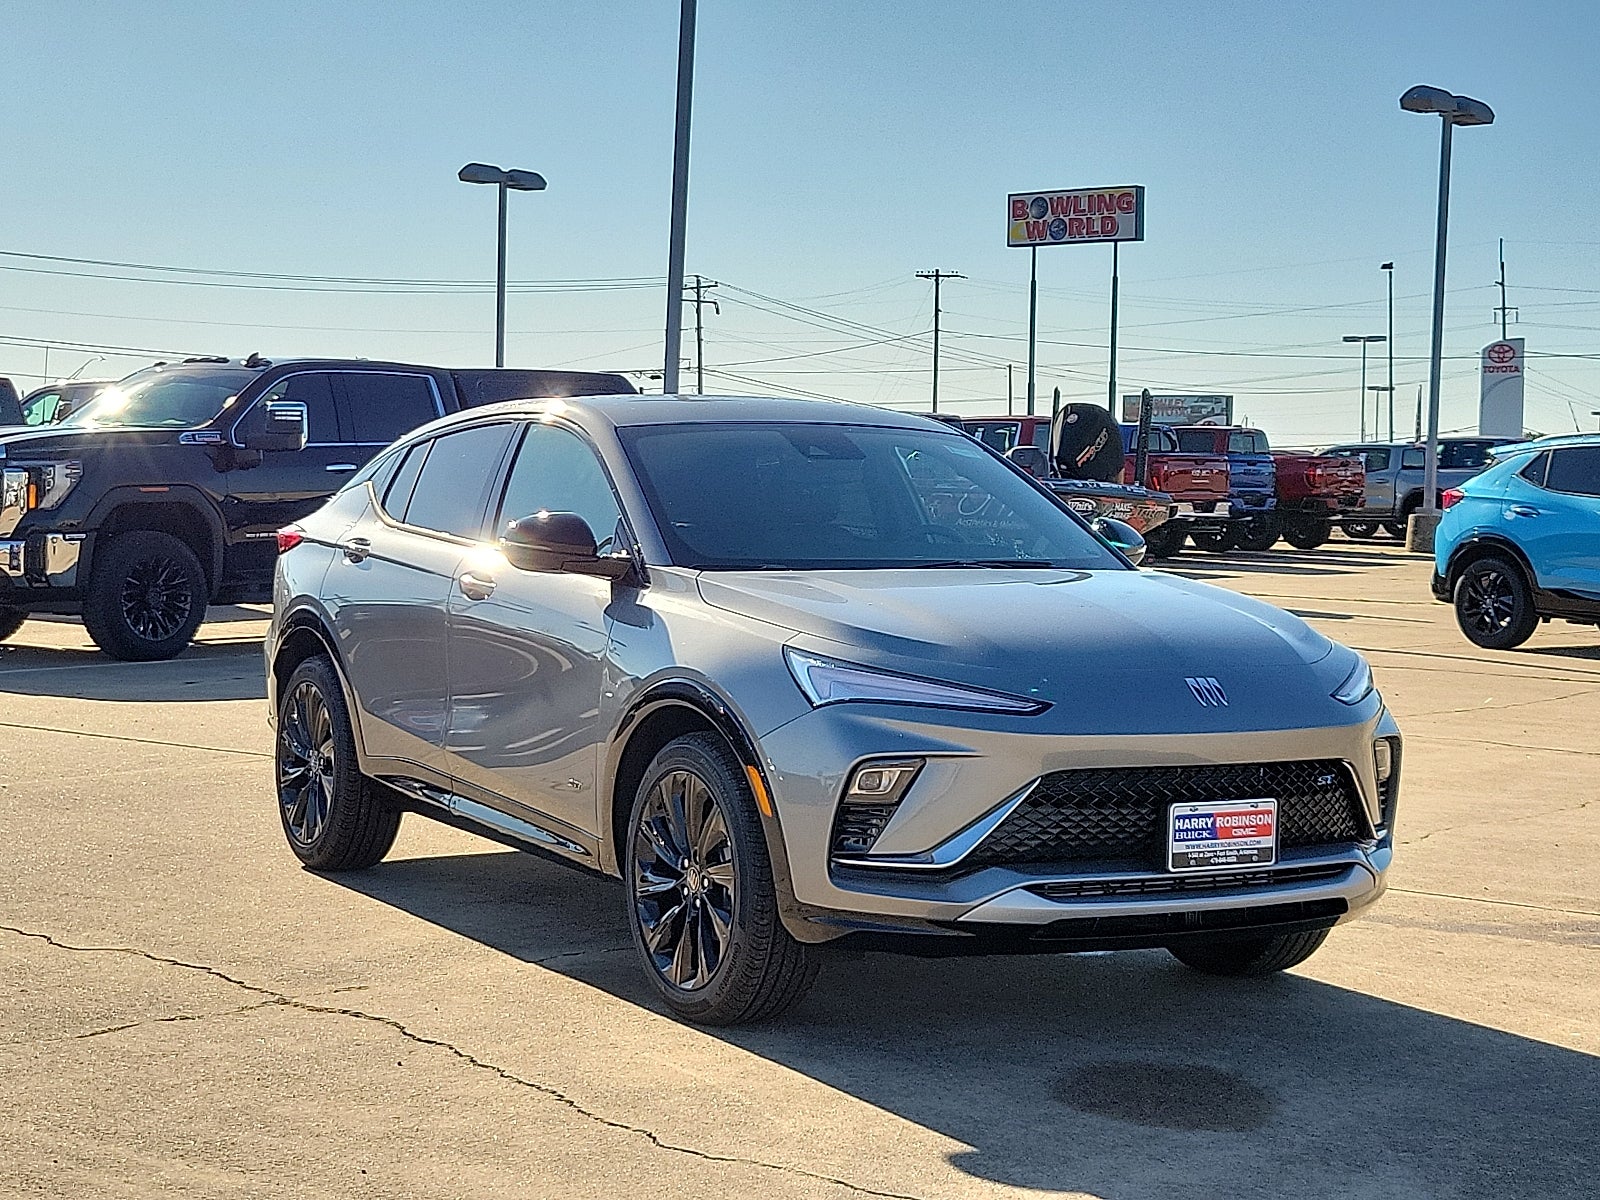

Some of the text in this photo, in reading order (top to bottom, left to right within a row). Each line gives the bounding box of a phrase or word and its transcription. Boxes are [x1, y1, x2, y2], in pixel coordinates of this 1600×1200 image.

[1012, 192, 1135, 220] BOWLING
[1025, 215, 1119, 241] WORLD
[1482, 365, 1521, 374] TOYOTA
[1175, 813, 1272, 830] HARRY ROBINSON
[1174, 827, 1258, 840] BUICK GMC
